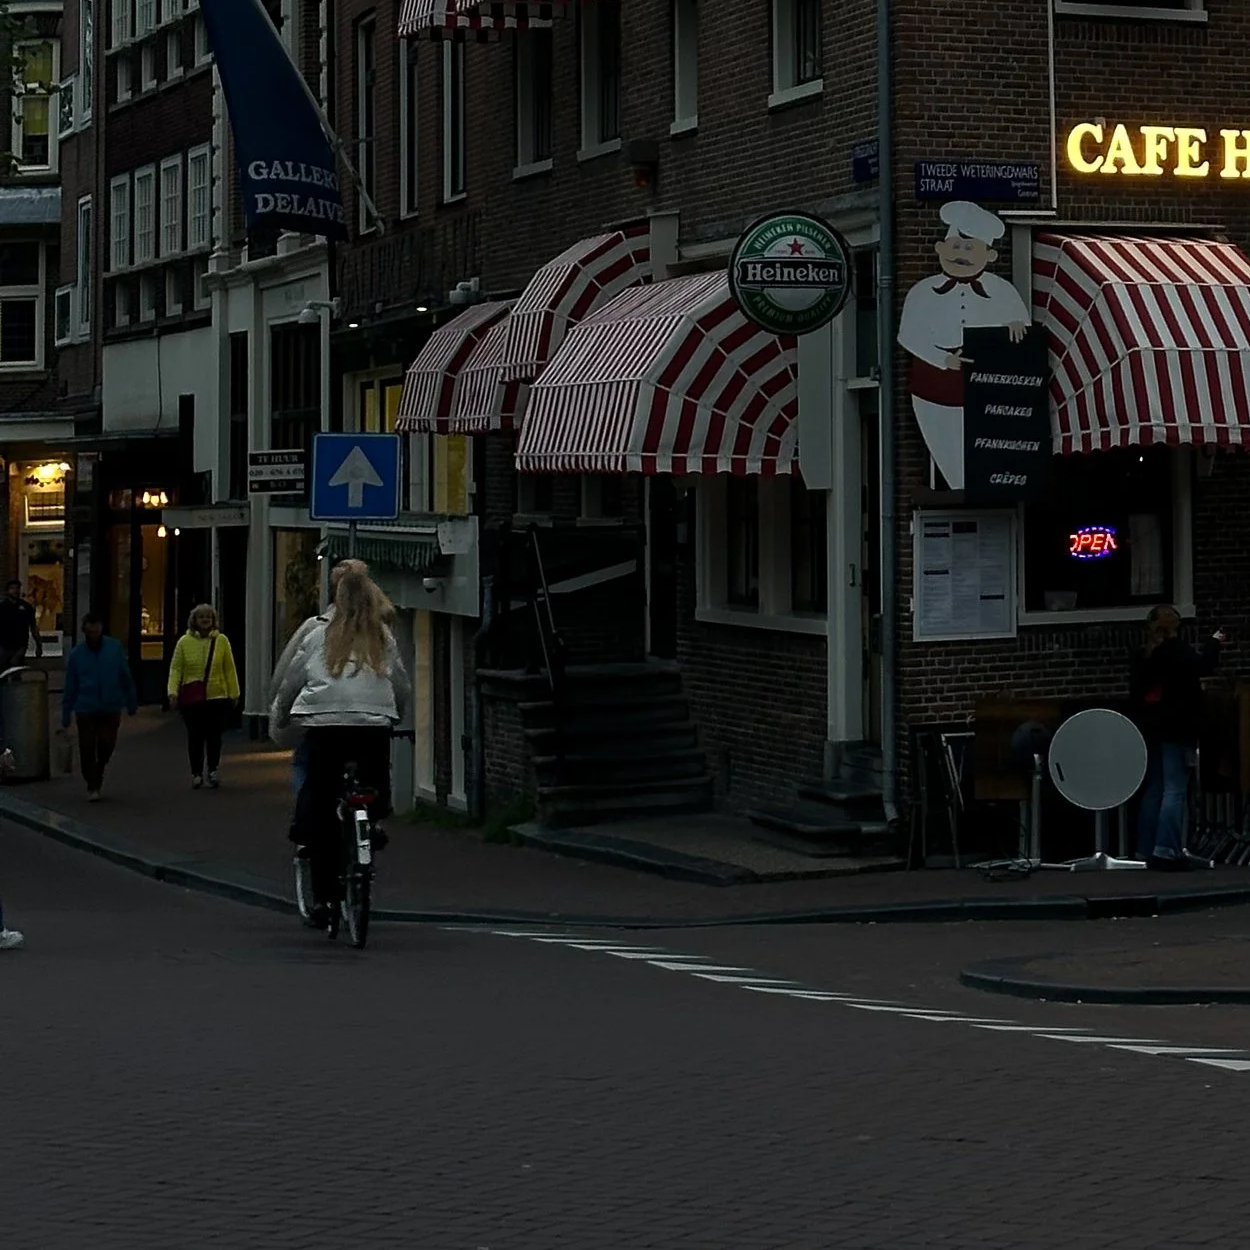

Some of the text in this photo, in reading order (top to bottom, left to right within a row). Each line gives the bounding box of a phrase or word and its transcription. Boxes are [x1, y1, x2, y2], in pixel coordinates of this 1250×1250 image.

[1067, 123, 1209, 177] CAFE
[920, 163, 1038, 179] TWEEDE WETERINGDWARS
[920, 178, 954, 192] STRAAT
[746, 263, 840, 282] Heineken
[984, 403, 1033, 418] PANCAKES
